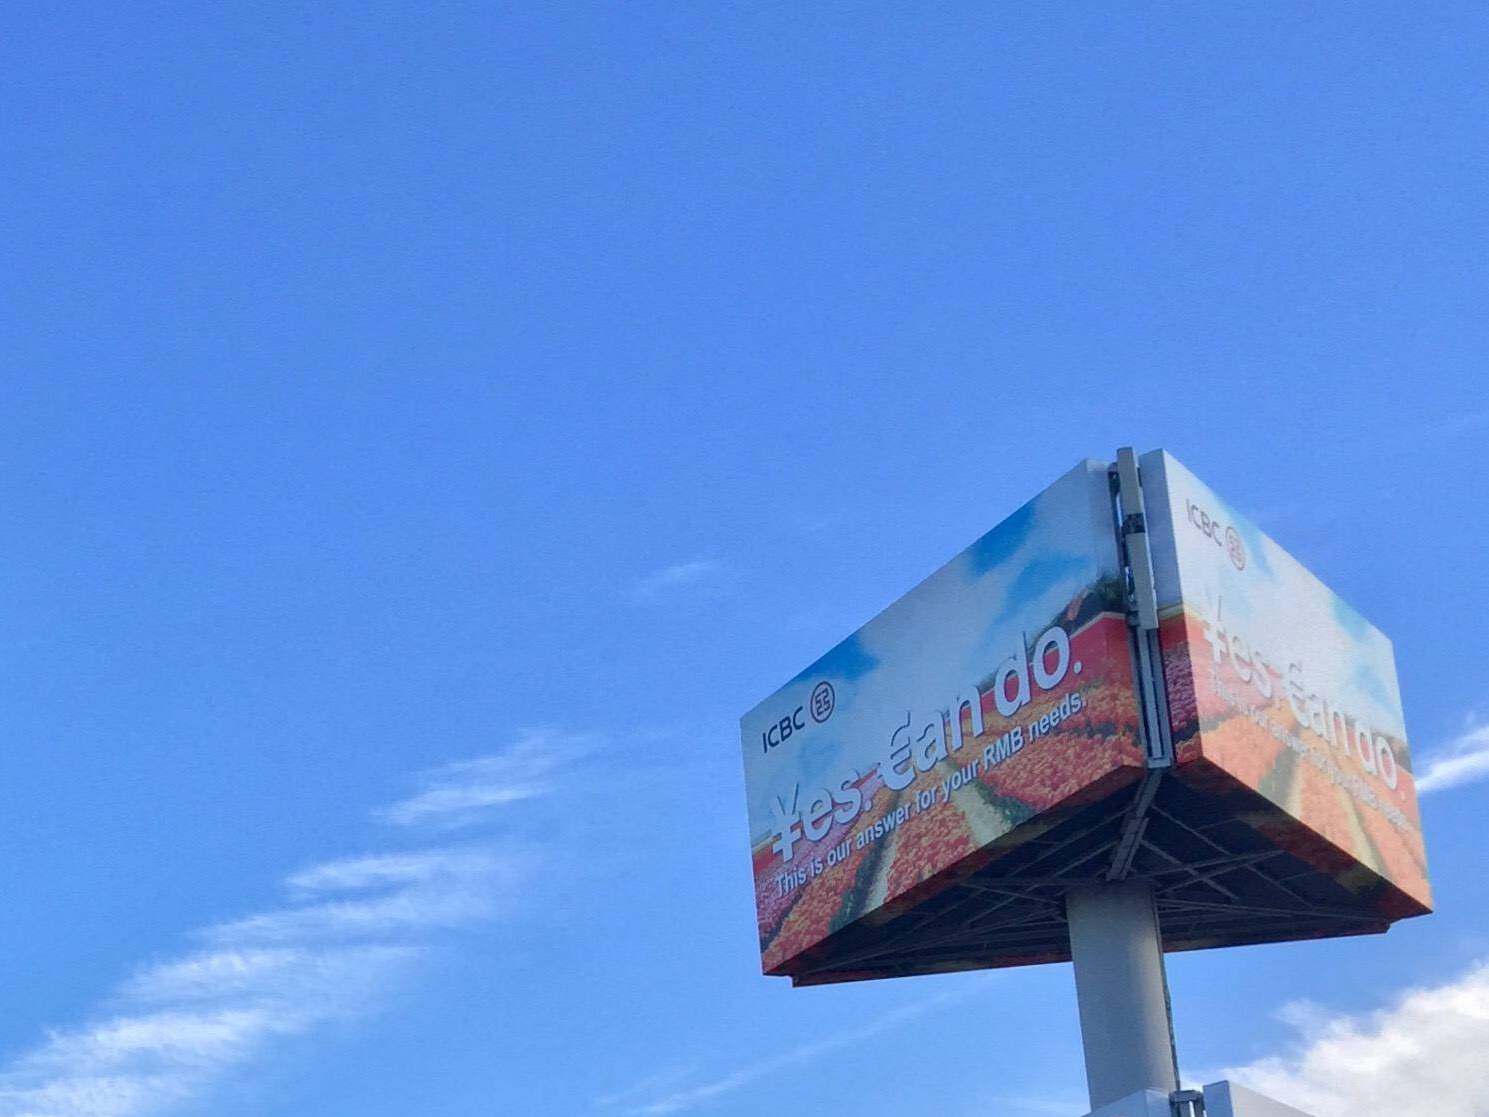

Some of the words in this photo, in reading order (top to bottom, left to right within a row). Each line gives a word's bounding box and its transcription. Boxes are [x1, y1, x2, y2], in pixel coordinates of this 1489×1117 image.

[1186, 498, 1222, 547] ICBC
[994, 626, 1083, 718] do.
[762, 705, 805, 753] ICBC
[776, 868, 807, 897] This
[811, 858, 823, 878] is
[827, 838, 853, 867] our
[856, 804, 911, 850] answer
[915, 784, 937, 814] for
[943, 758, 980, 802] your
[983, 726, 1024, 770] RMB
[1028, 692, 1087, 743] needs.
